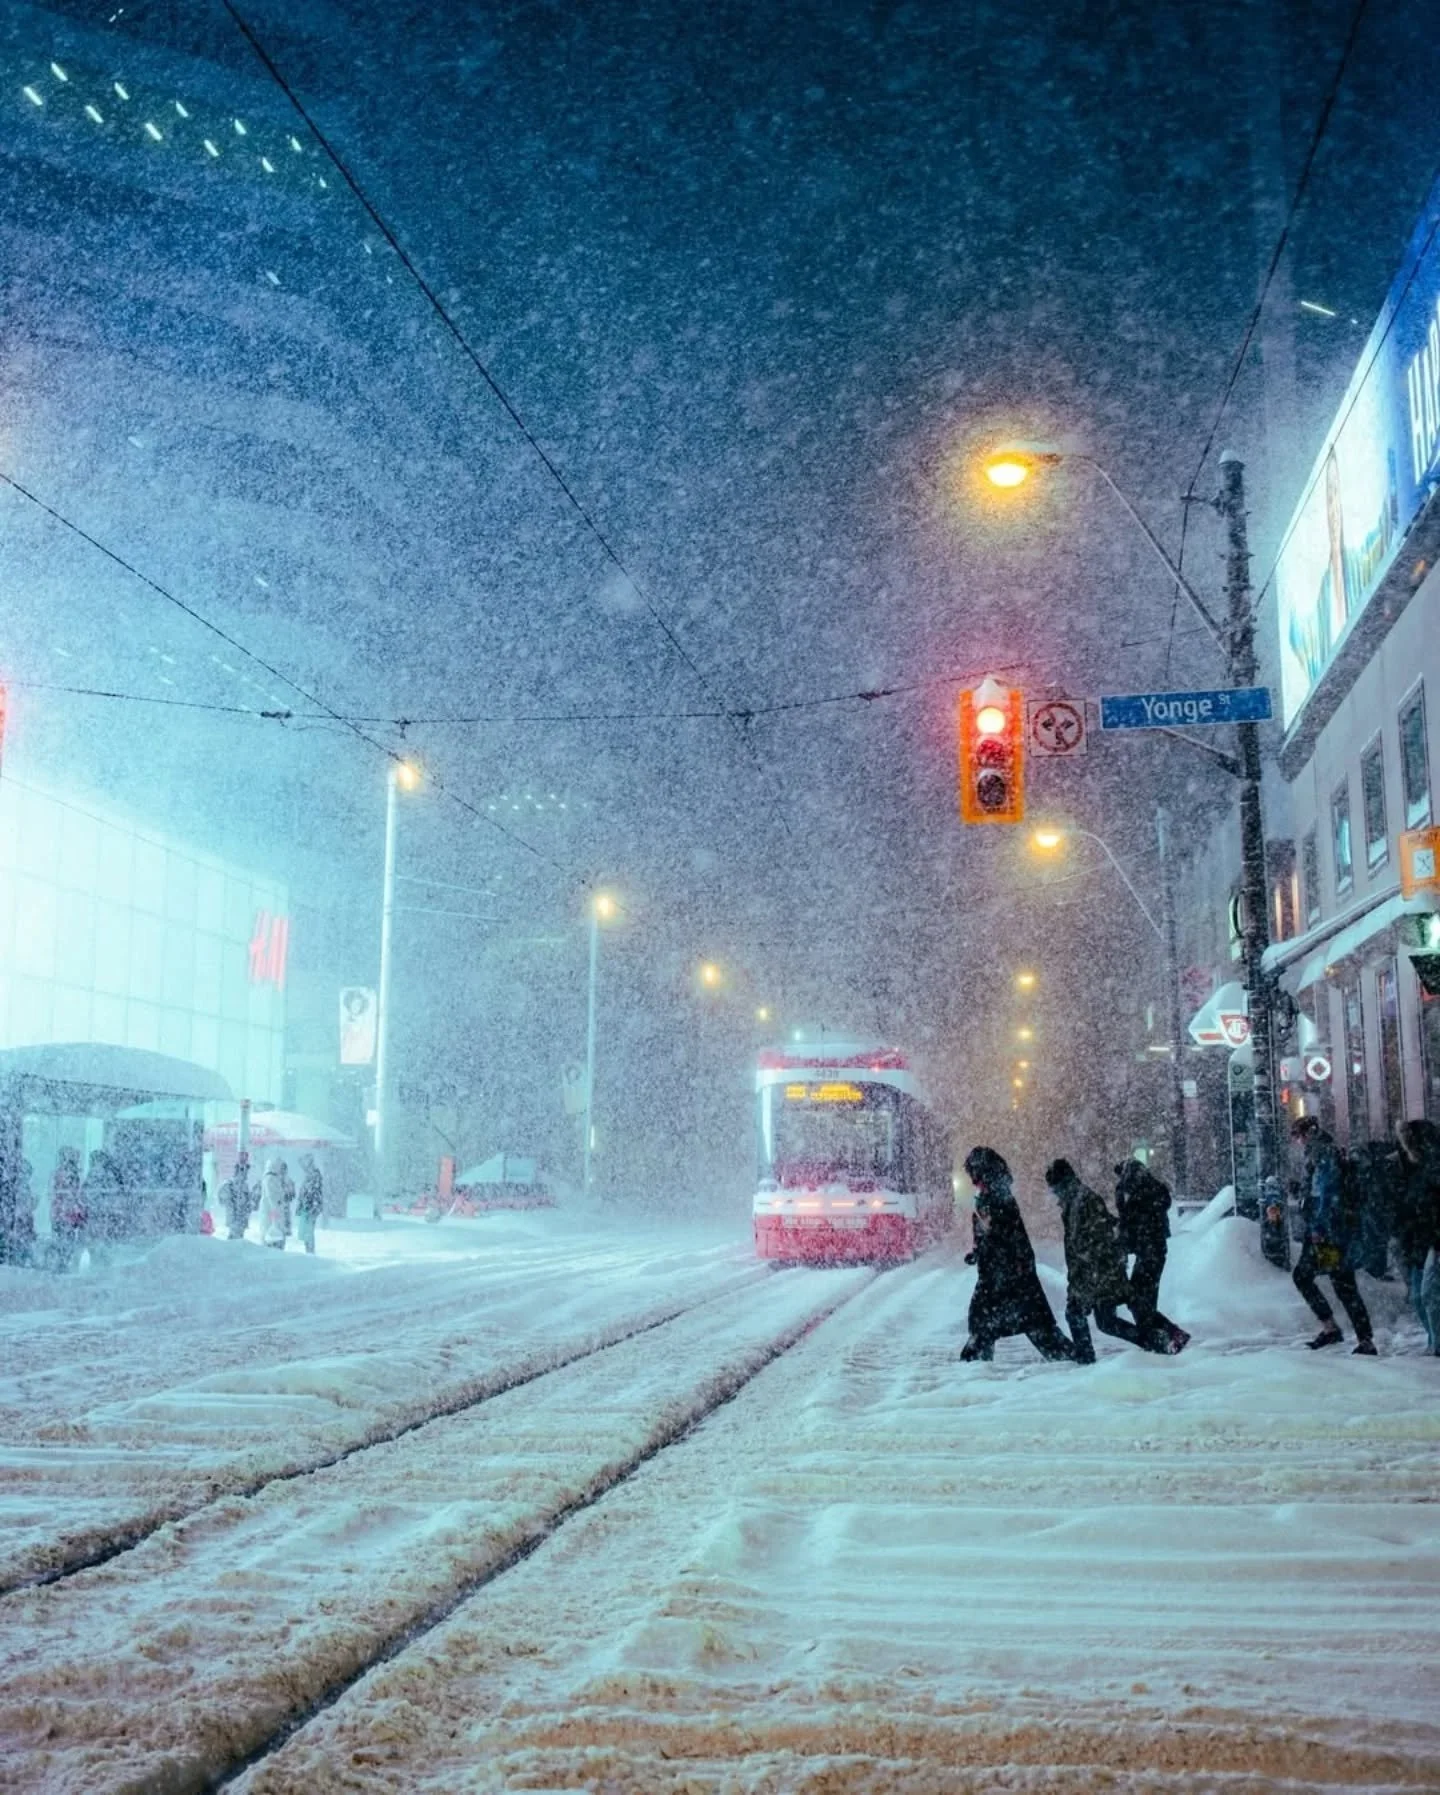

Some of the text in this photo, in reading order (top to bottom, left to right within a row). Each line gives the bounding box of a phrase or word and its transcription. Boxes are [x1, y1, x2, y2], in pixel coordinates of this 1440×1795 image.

[1407, 290, 1440, 486] HAP
[1141, 693, 1231, 723] Yonge St
